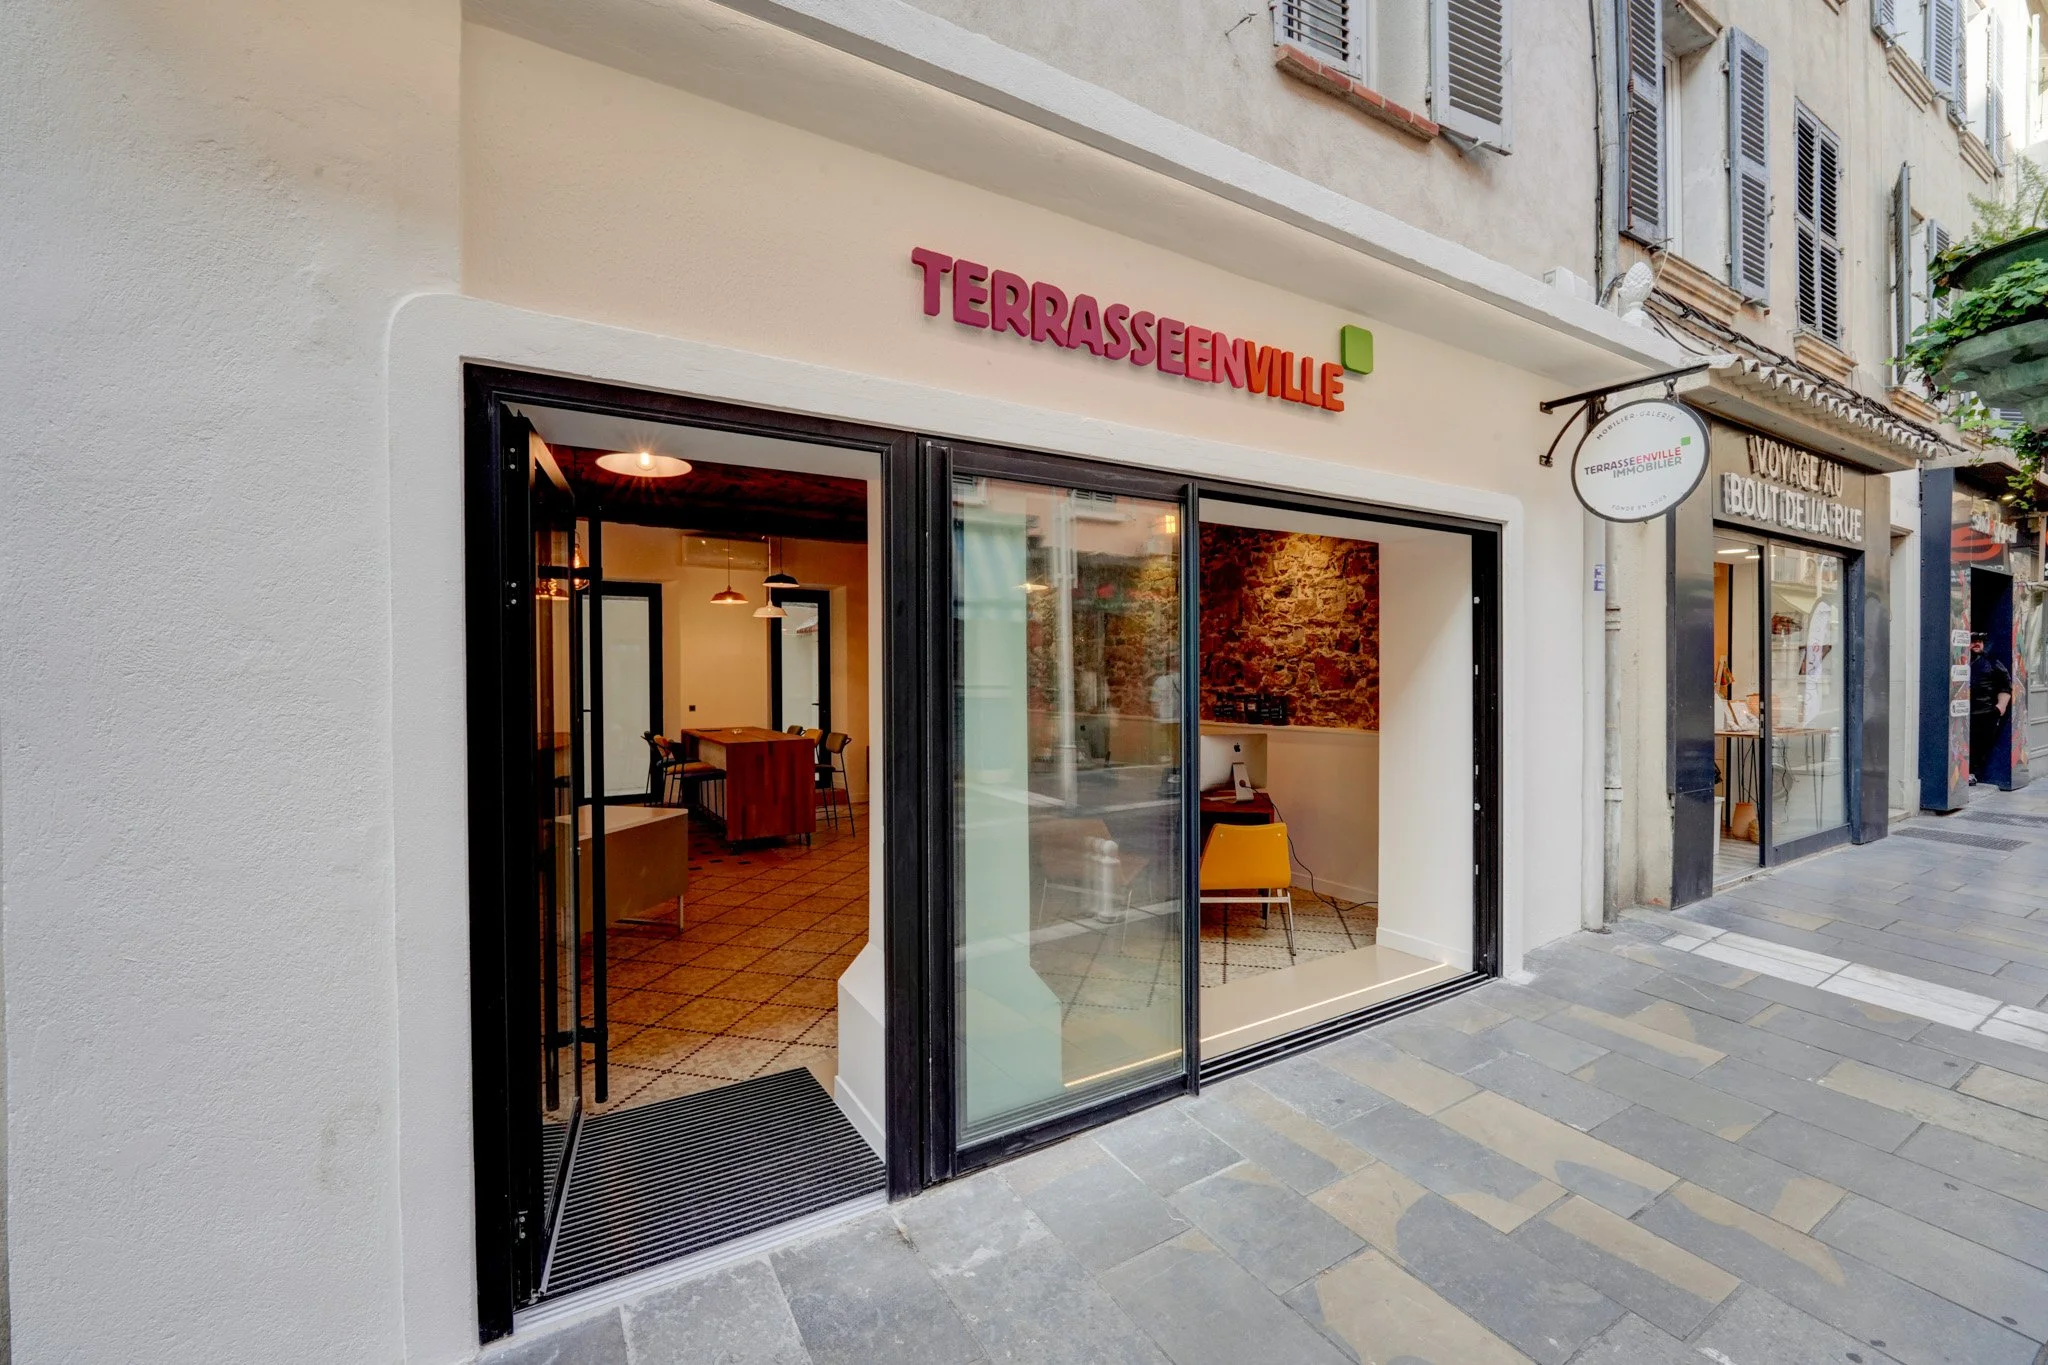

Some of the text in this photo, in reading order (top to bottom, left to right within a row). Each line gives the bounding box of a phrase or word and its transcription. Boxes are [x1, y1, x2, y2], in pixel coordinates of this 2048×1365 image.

[911, 246, 1344, 413] TERRASSEENVILLE
[1596, 413, 1635, 440] MOBILIER
[1584, 446, 1681, 476] TERRASSEENVILLE
[1613, 456, 1682, 479] IMMOBILIER
[1755, 435, 1844, 498] VOYAGE AU
[1727, 472, 1862, 542] BOUT DE LA RUE
